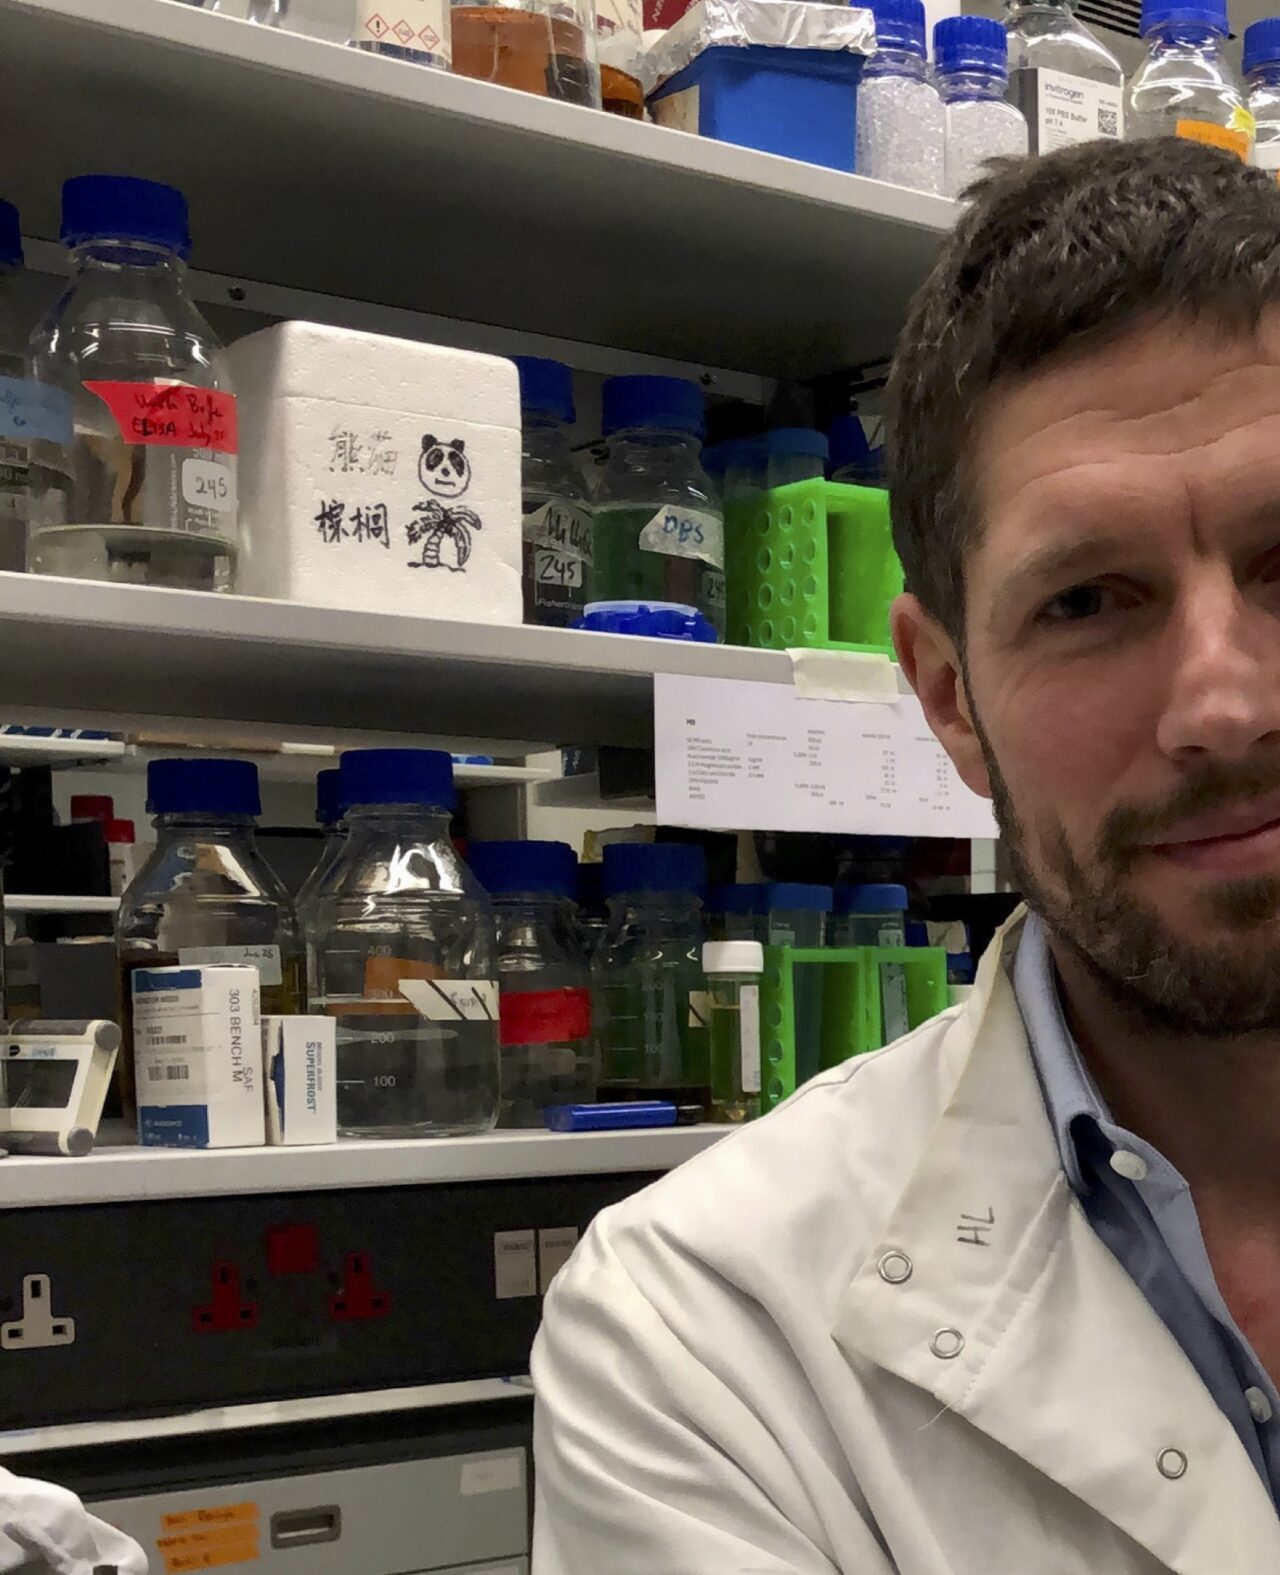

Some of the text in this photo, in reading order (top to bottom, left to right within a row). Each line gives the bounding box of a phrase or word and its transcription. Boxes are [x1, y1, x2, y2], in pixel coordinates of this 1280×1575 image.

[1045, 81, 1084, 99] invitrogen
[195, 477, 227, 499] 245
[540, 554, 577, 585] 245
[229, 989, 241, 1013] 303
[229, 1017, 242, 1066] BENCH
[306, 1041, 316, 1112] SUPERFROST
[373, 1075, 396, 1087] 100
[957, 1206, 995, 1247] HL
